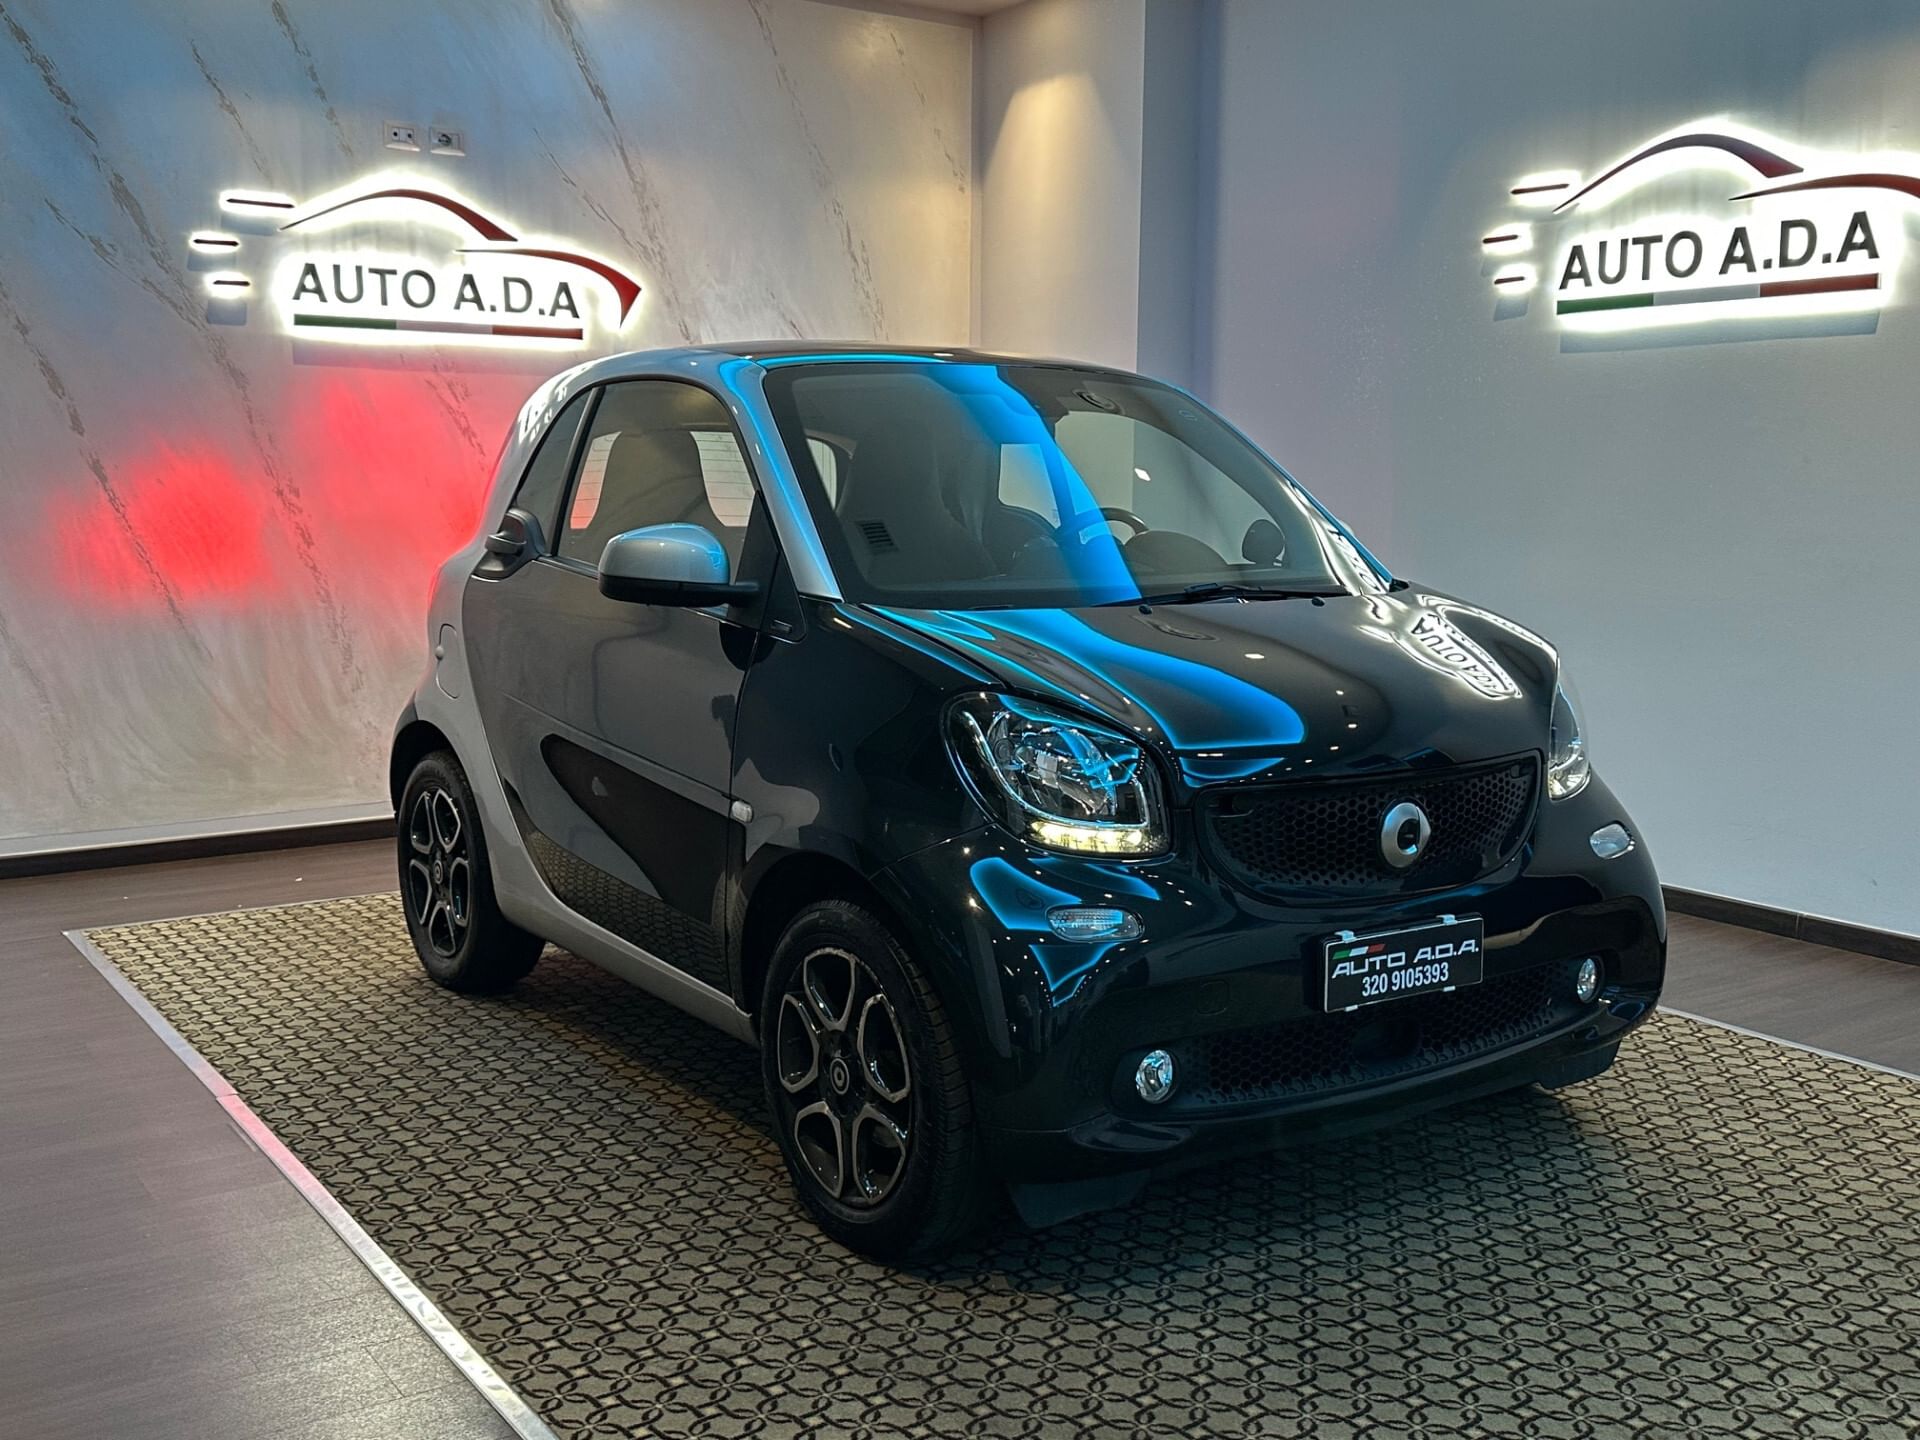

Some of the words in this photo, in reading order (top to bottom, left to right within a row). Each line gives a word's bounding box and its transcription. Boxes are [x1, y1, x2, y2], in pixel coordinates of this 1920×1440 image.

[1559, 231, 1703, 290] AUTO
[1719, 211, 1880, 276] A.D.A
[293, 262, 436, 309] AUTO
[453, 273, 581, 319] A.D.A
[1332, 952, 1406, 979] AUTO
[1413, 939, 1479, 963] A.D.A.
[1362, 974, 1388, 997] 320
[1391, 962, 1449, 991] 9105393
